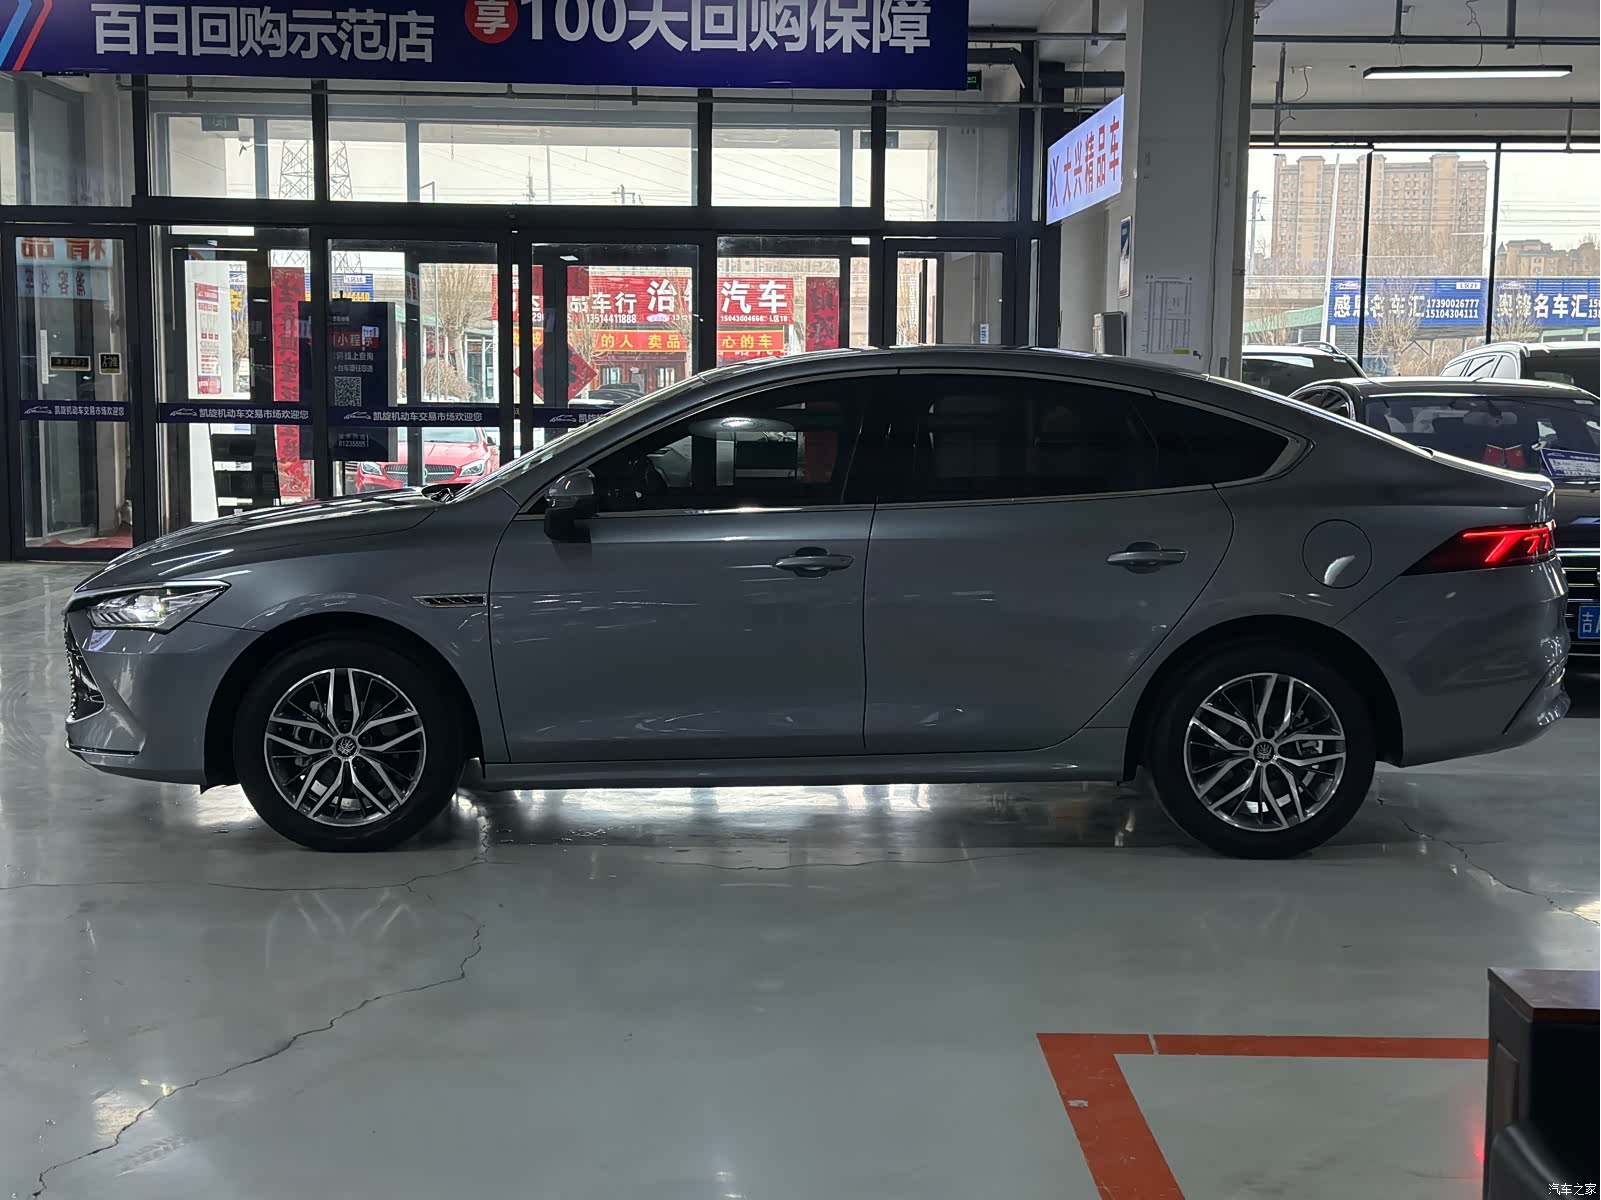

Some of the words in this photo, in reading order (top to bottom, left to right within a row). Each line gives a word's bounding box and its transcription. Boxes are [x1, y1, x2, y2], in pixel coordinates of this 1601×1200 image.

[473, 0, 510, 35] 享
[91, 4, 435, 63] 百日回购示范店
[1063, 115, 1120, 206] 大兴精品车
[1426, 299, 1480, 309] 17390026777
[1425, 309, 1479, 318] 15104304111
[54, 405, 125, 417] 凯旋机动车交易市场欢迎您
[199, 408, 309, 420] 凯旋机动车交易市场欢迎您
[372, 411, 483, 422] 凯旋机动车交易市场欢迎您
